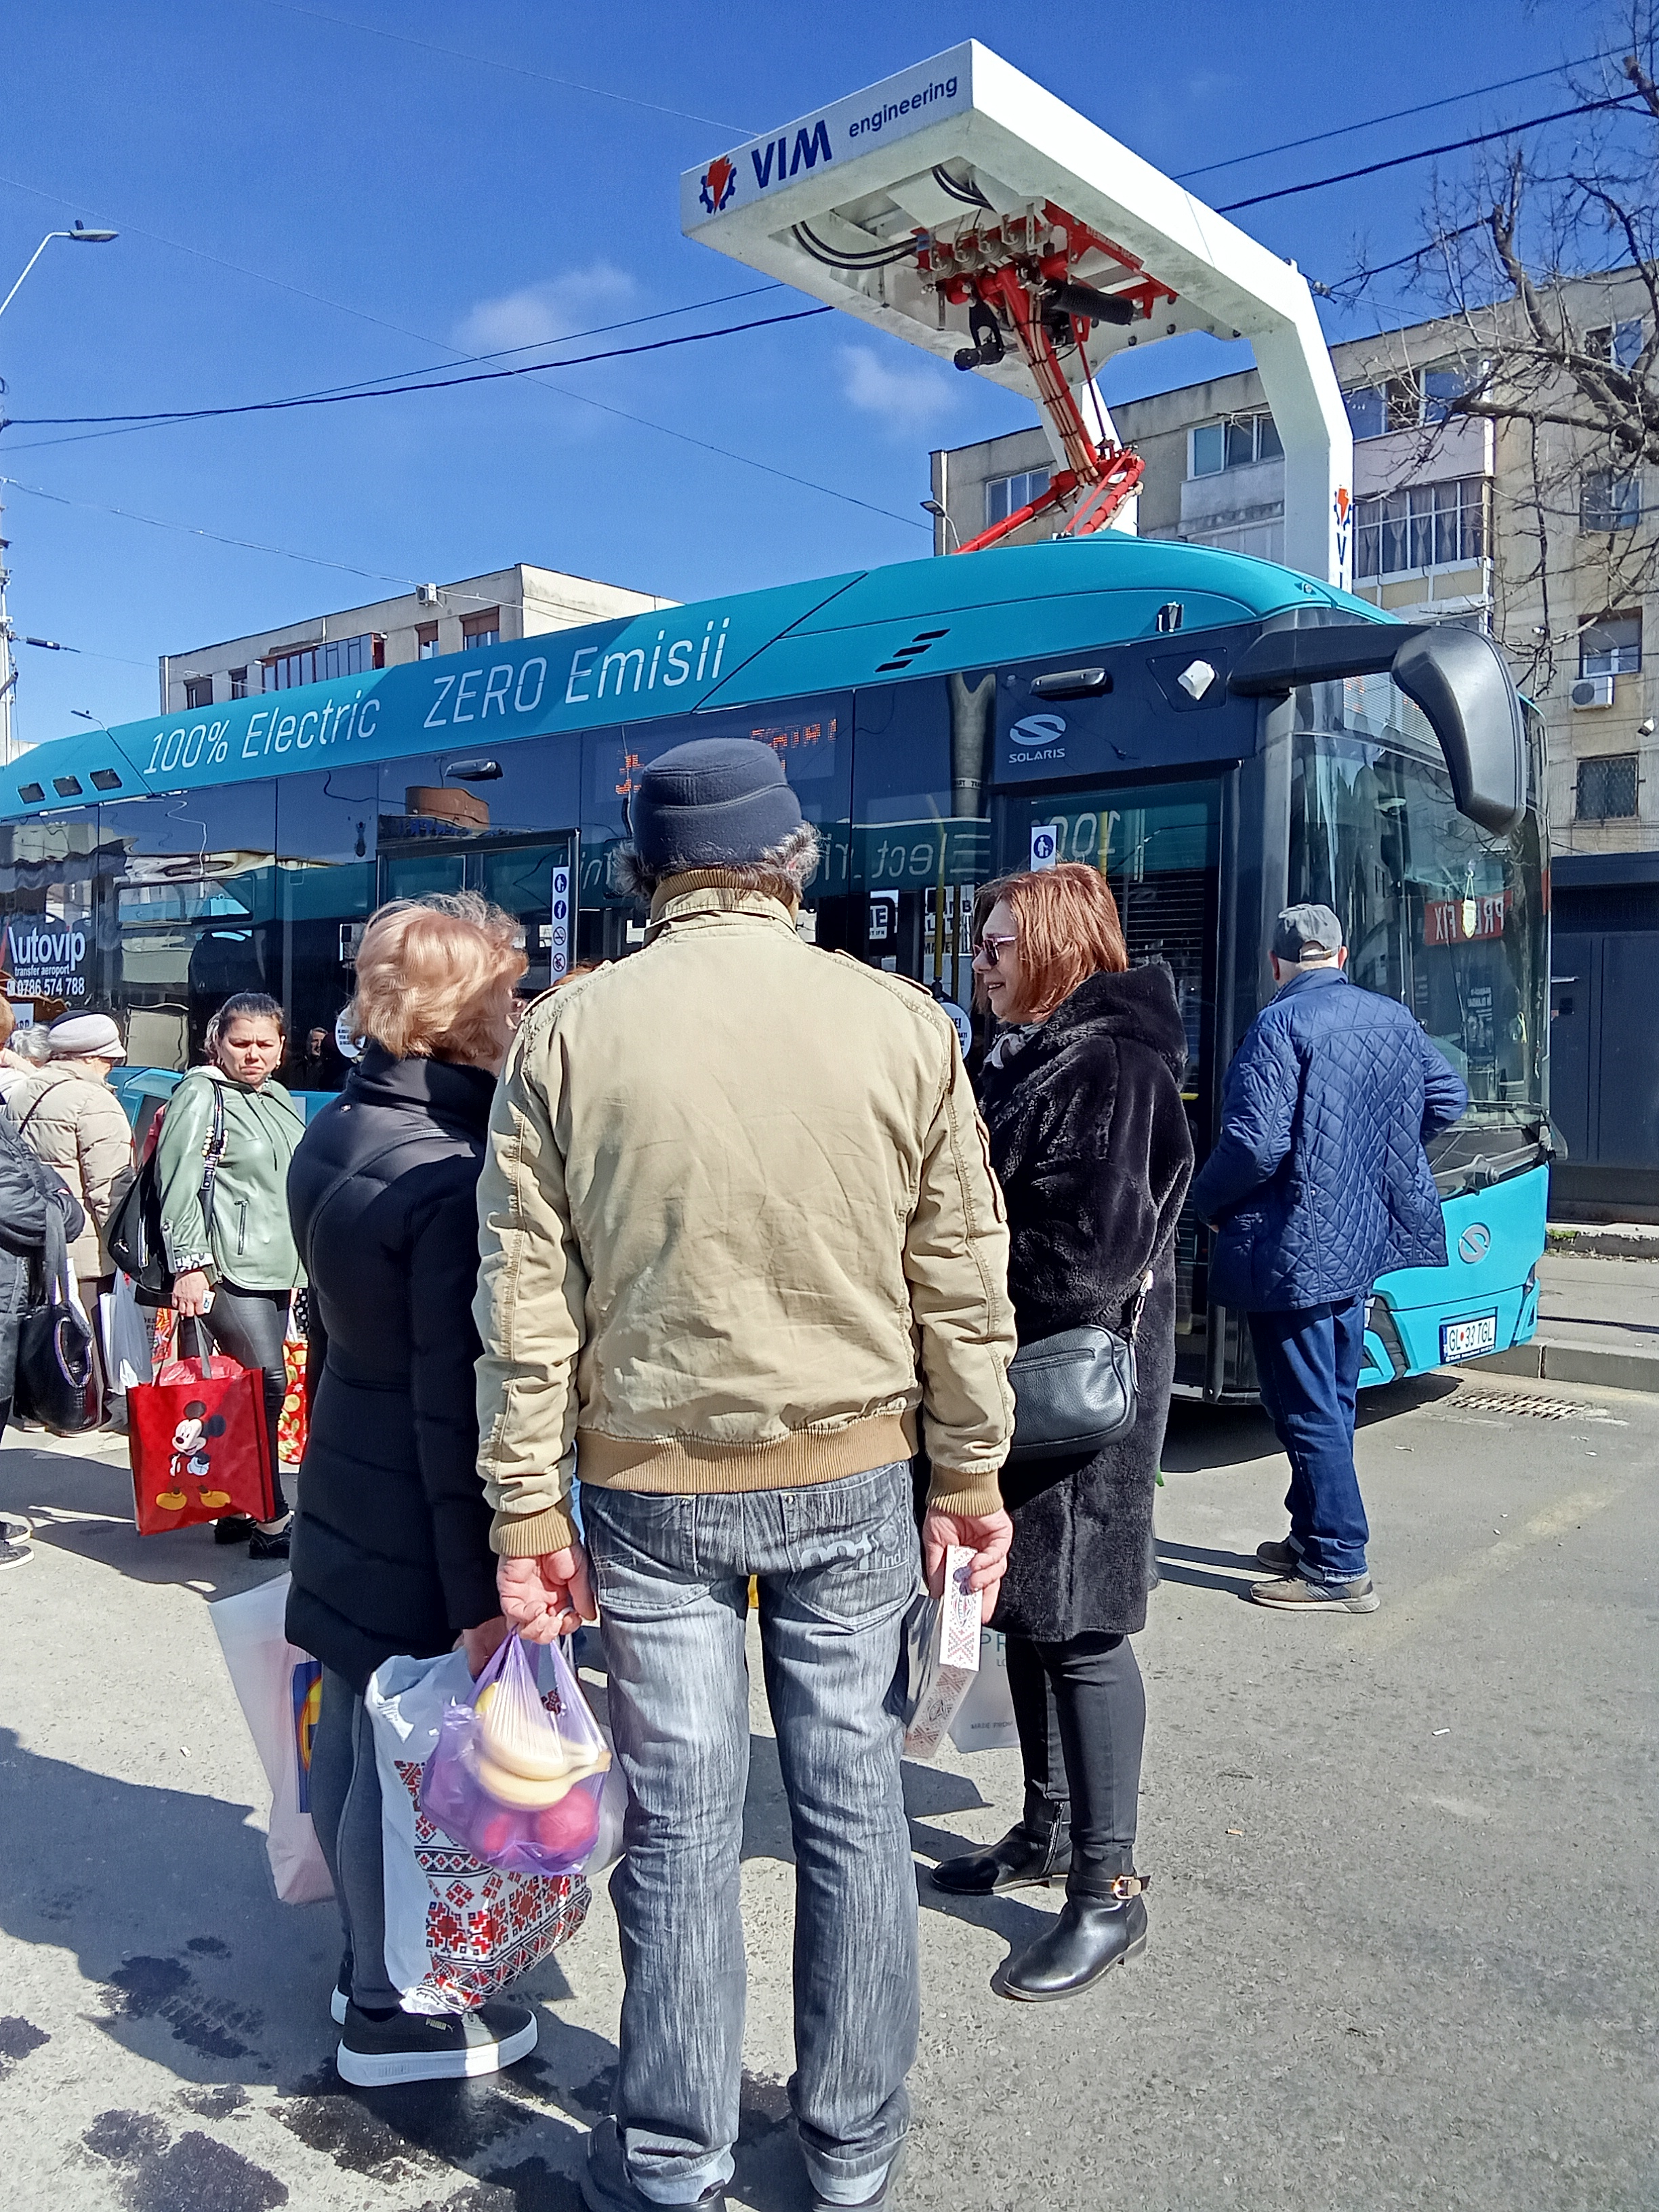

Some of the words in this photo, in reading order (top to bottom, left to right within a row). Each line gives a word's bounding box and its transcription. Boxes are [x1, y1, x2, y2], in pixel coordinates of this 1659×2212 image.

[752, 120, 832, 188] VIM
[849, 76, 958, 137] engineering
[143, 720, 229, 775] 100%
[241, 690, 380, 759] Electric
[423, 657, 546, 729] ZERO
[565, 616, 732, 705] Emisii
[1008, 747, 1065, 764] SOLARIS
[14, 966, 40, 977] transfer
[41, 964, 70, 977] aeroport
[18, 979, 41, 995] 0786
[43, 978, 63, 996] 574
[65, 977, 85, 996] 788
[1449, 1329, 1461, 1351] GL
[1465, 1325, 1475, 1348] 33
[1477, 1321, 1492, 1345] TGL
[426, 2018, 447, 2030] PUMA
